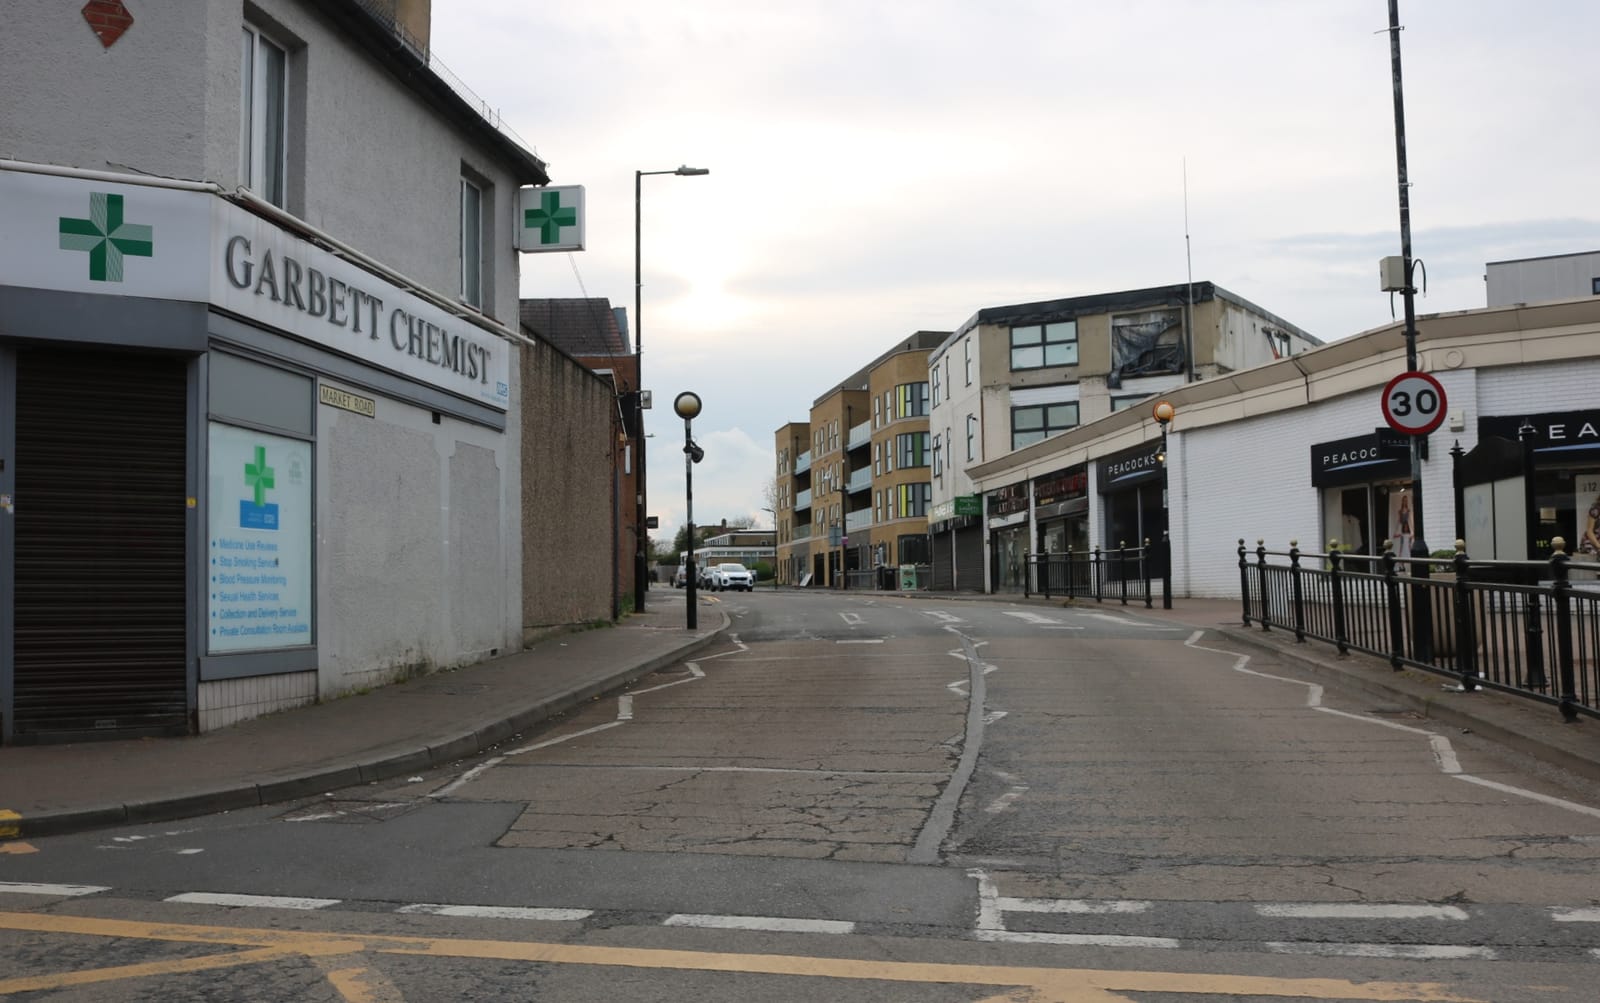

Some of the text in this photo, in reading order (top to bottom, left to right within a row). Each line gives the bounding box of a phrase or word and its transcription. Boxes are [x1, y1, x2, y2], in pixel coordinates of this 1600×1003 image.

[226, 235, 492, 384] GARBETT CHEMIST
[322, 387, 373, 414] MARKET ROAD
[1391, 389, 1438, 417] 30
[1108, 453, 1156, 476] PEACOCKS
[1323, 447, 1377, 465] PEACOC
